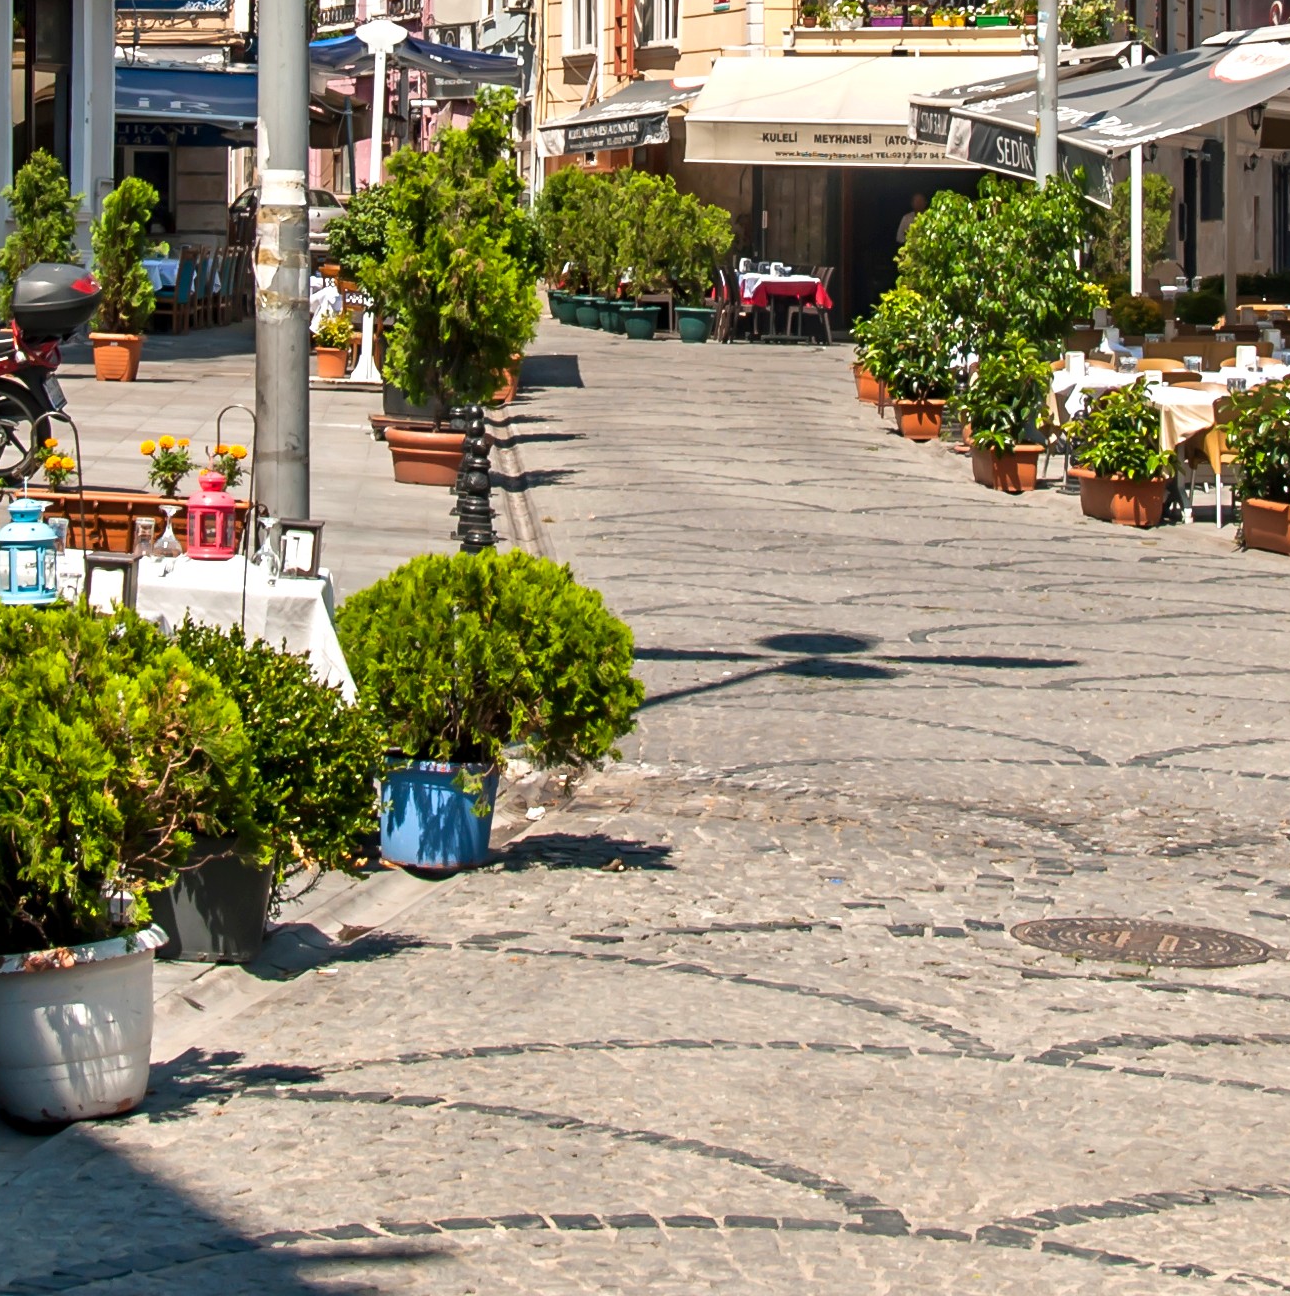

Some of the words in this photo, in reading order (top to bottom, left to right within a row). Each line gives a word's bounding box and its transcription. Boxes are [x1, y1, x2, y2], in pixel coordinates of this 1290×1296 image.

[762, 131, 798, 143] KULELİ
[814, 133, 872, 145] MEYHANESİ
[996, 135, 1034, 172] SEDİR
